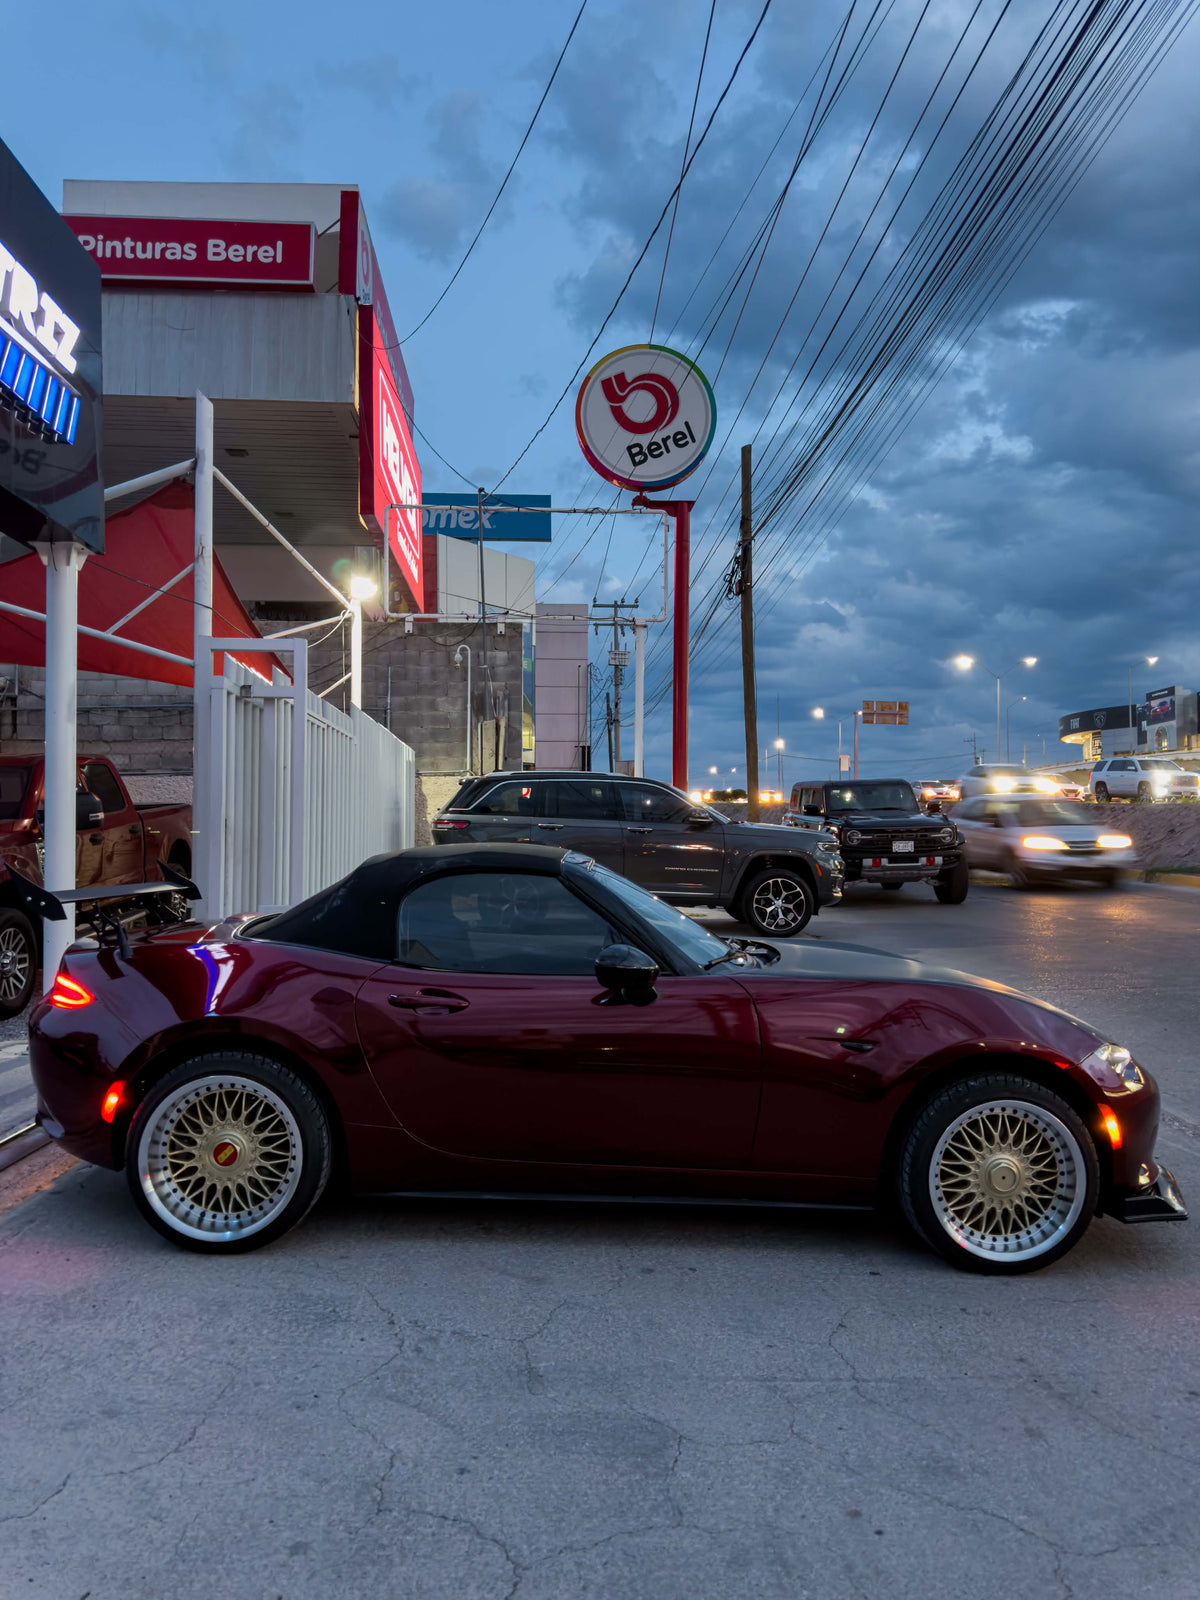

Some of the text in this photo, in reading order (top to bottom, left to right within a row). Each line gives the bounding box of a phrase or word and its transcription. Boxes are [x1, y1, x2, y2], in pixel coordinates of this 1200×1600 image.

[77, 235, 283, 264] Pinturas Berel
[626, 420, 697, 468] Berel
